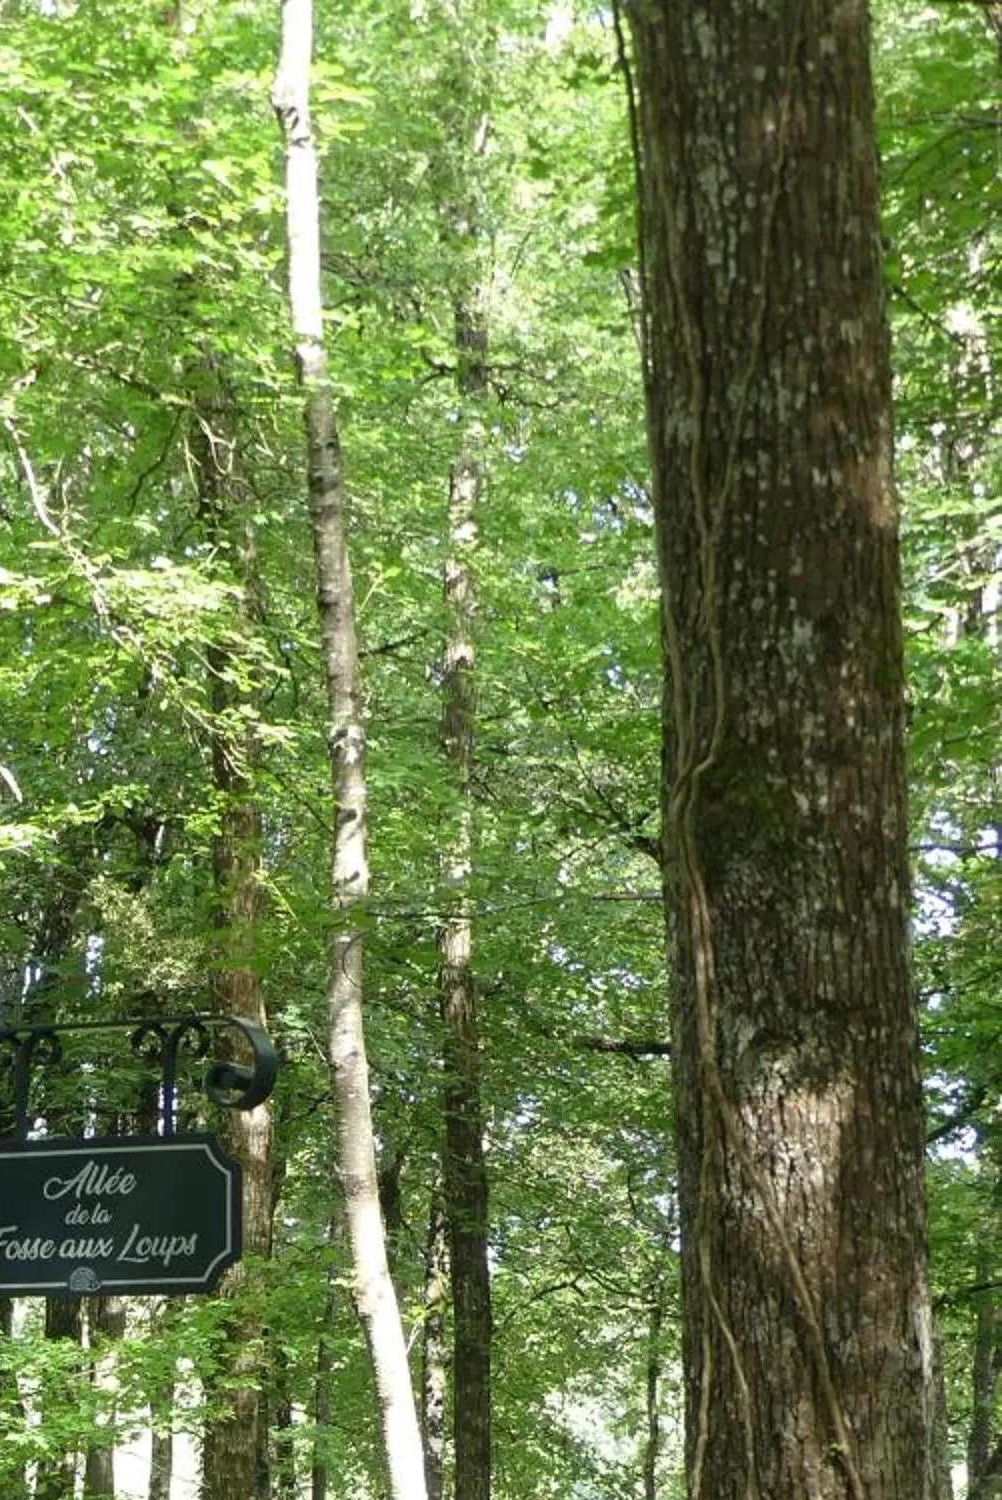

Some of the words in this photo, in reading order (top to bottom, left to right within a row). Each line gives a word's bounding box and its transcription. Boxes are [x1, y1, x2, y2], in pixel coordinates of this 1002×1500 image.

[43, 1160, 137, 1200] Allée
[65, 1203, 90, 1225] de
[91, 1203, 112, 1225] la
[58, 1236, 113, 1258] aux
[117, 1224, 198, 1267] Loups
